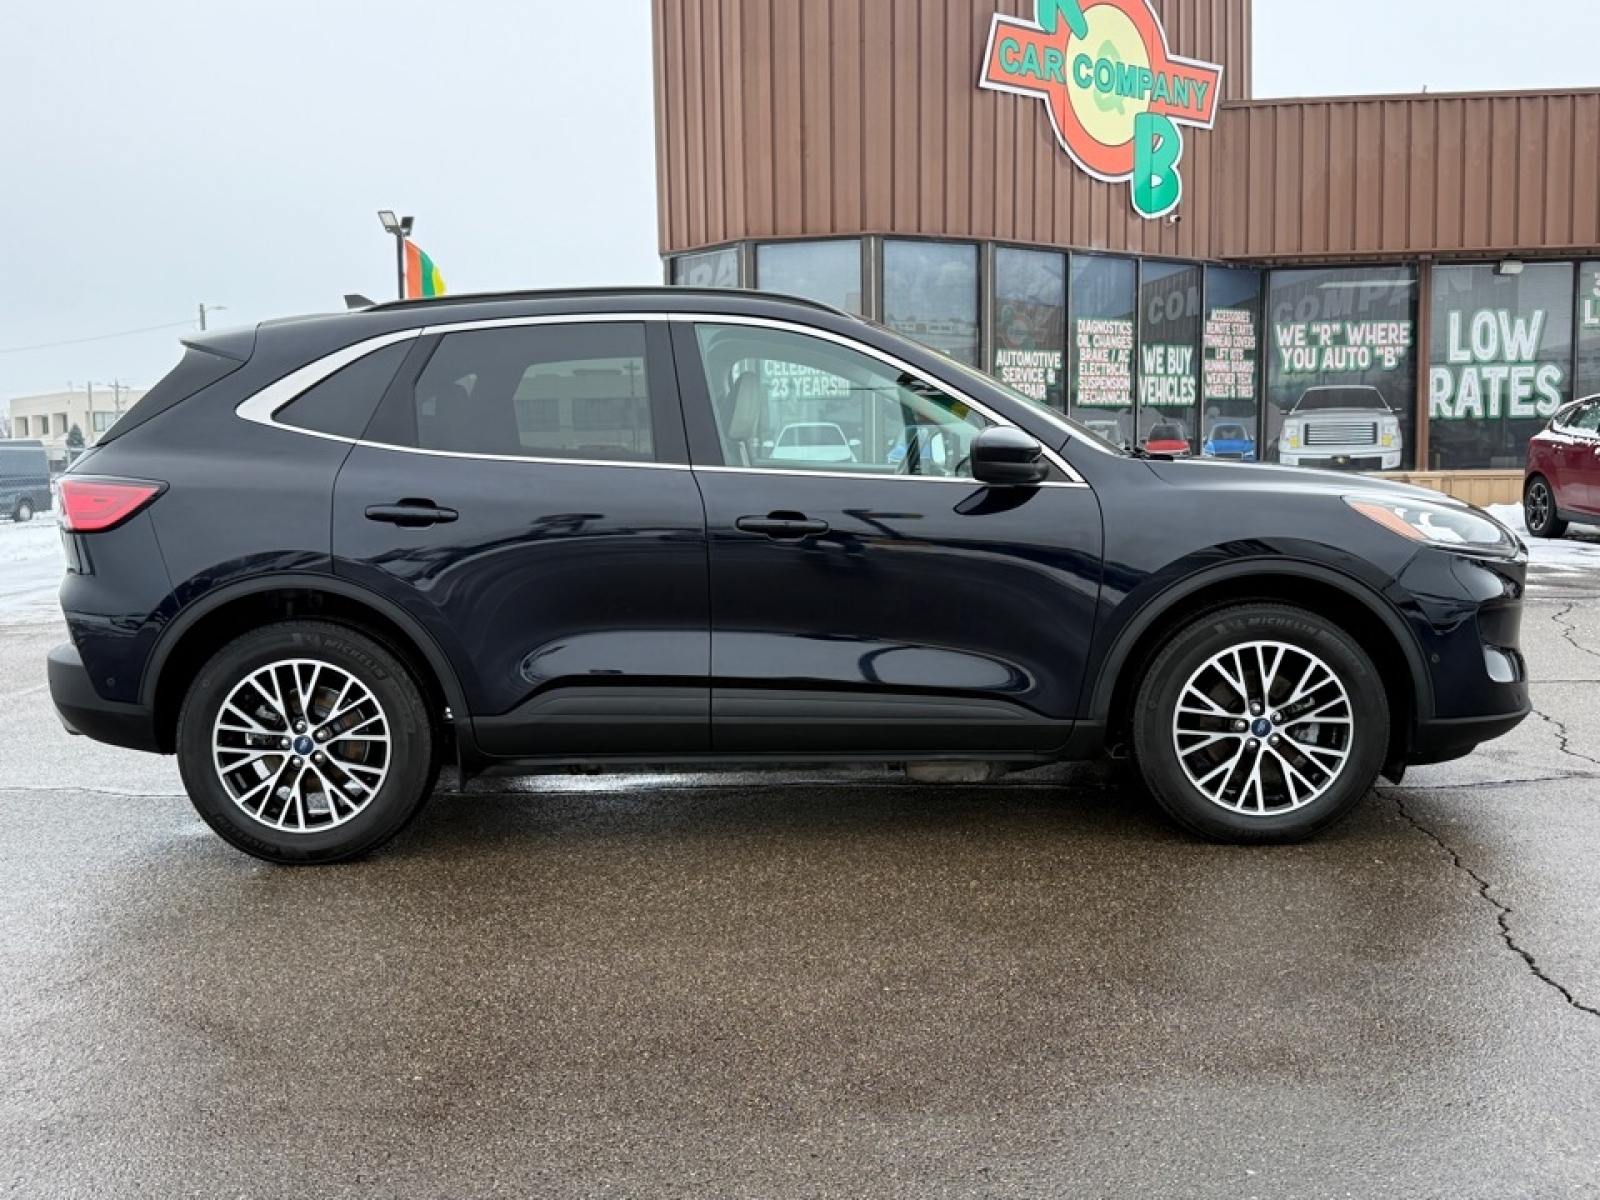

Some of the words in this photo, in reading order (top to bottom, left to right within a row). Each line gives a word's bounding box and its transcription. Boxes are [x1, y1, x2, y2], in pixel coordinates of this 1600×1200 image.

[999, 37, 1065, 84] CAR
[1073, 53, 1209, 111] COMPANY
[1077, 319, 1132, 334] DIAGNOSTICS
[1206, 321, 1230, 334] REMOTE
[1276, 324, 1306, 346] WE
[1347, 323, 1410, 345] WHERE
[1449, 309, 1545, 361] LOW
[1077, 334, 1090, 348] OIL
[1093, 335, 1132, 349] CHANGES
[996, 351, 1061, 367] AUTOMOTIVE
[1079, 348, 1109, 362] BRAKE
[1142, 344, 1165, 375] WE
[1167, 345, 1193, 375] BUY
[1281, 347, 1316, 370] YOU
[1322, 347, 1369, 369] AUTO
[1002, 367, 1045, 383] SERVICE
[1079, 362, 1131, 376] ELECTRICAL
[771, 378, 790, 397] 23
[1078, 376, 1131, 390] SUSPENSION
[1140, 376, 1195, 404] VEHICLES
[1430, 365, 1562, 417] RATES
[1077, 389, 1132, 405] MECHANICAL
[1248, 616, 1318, 635] MICHELIN
